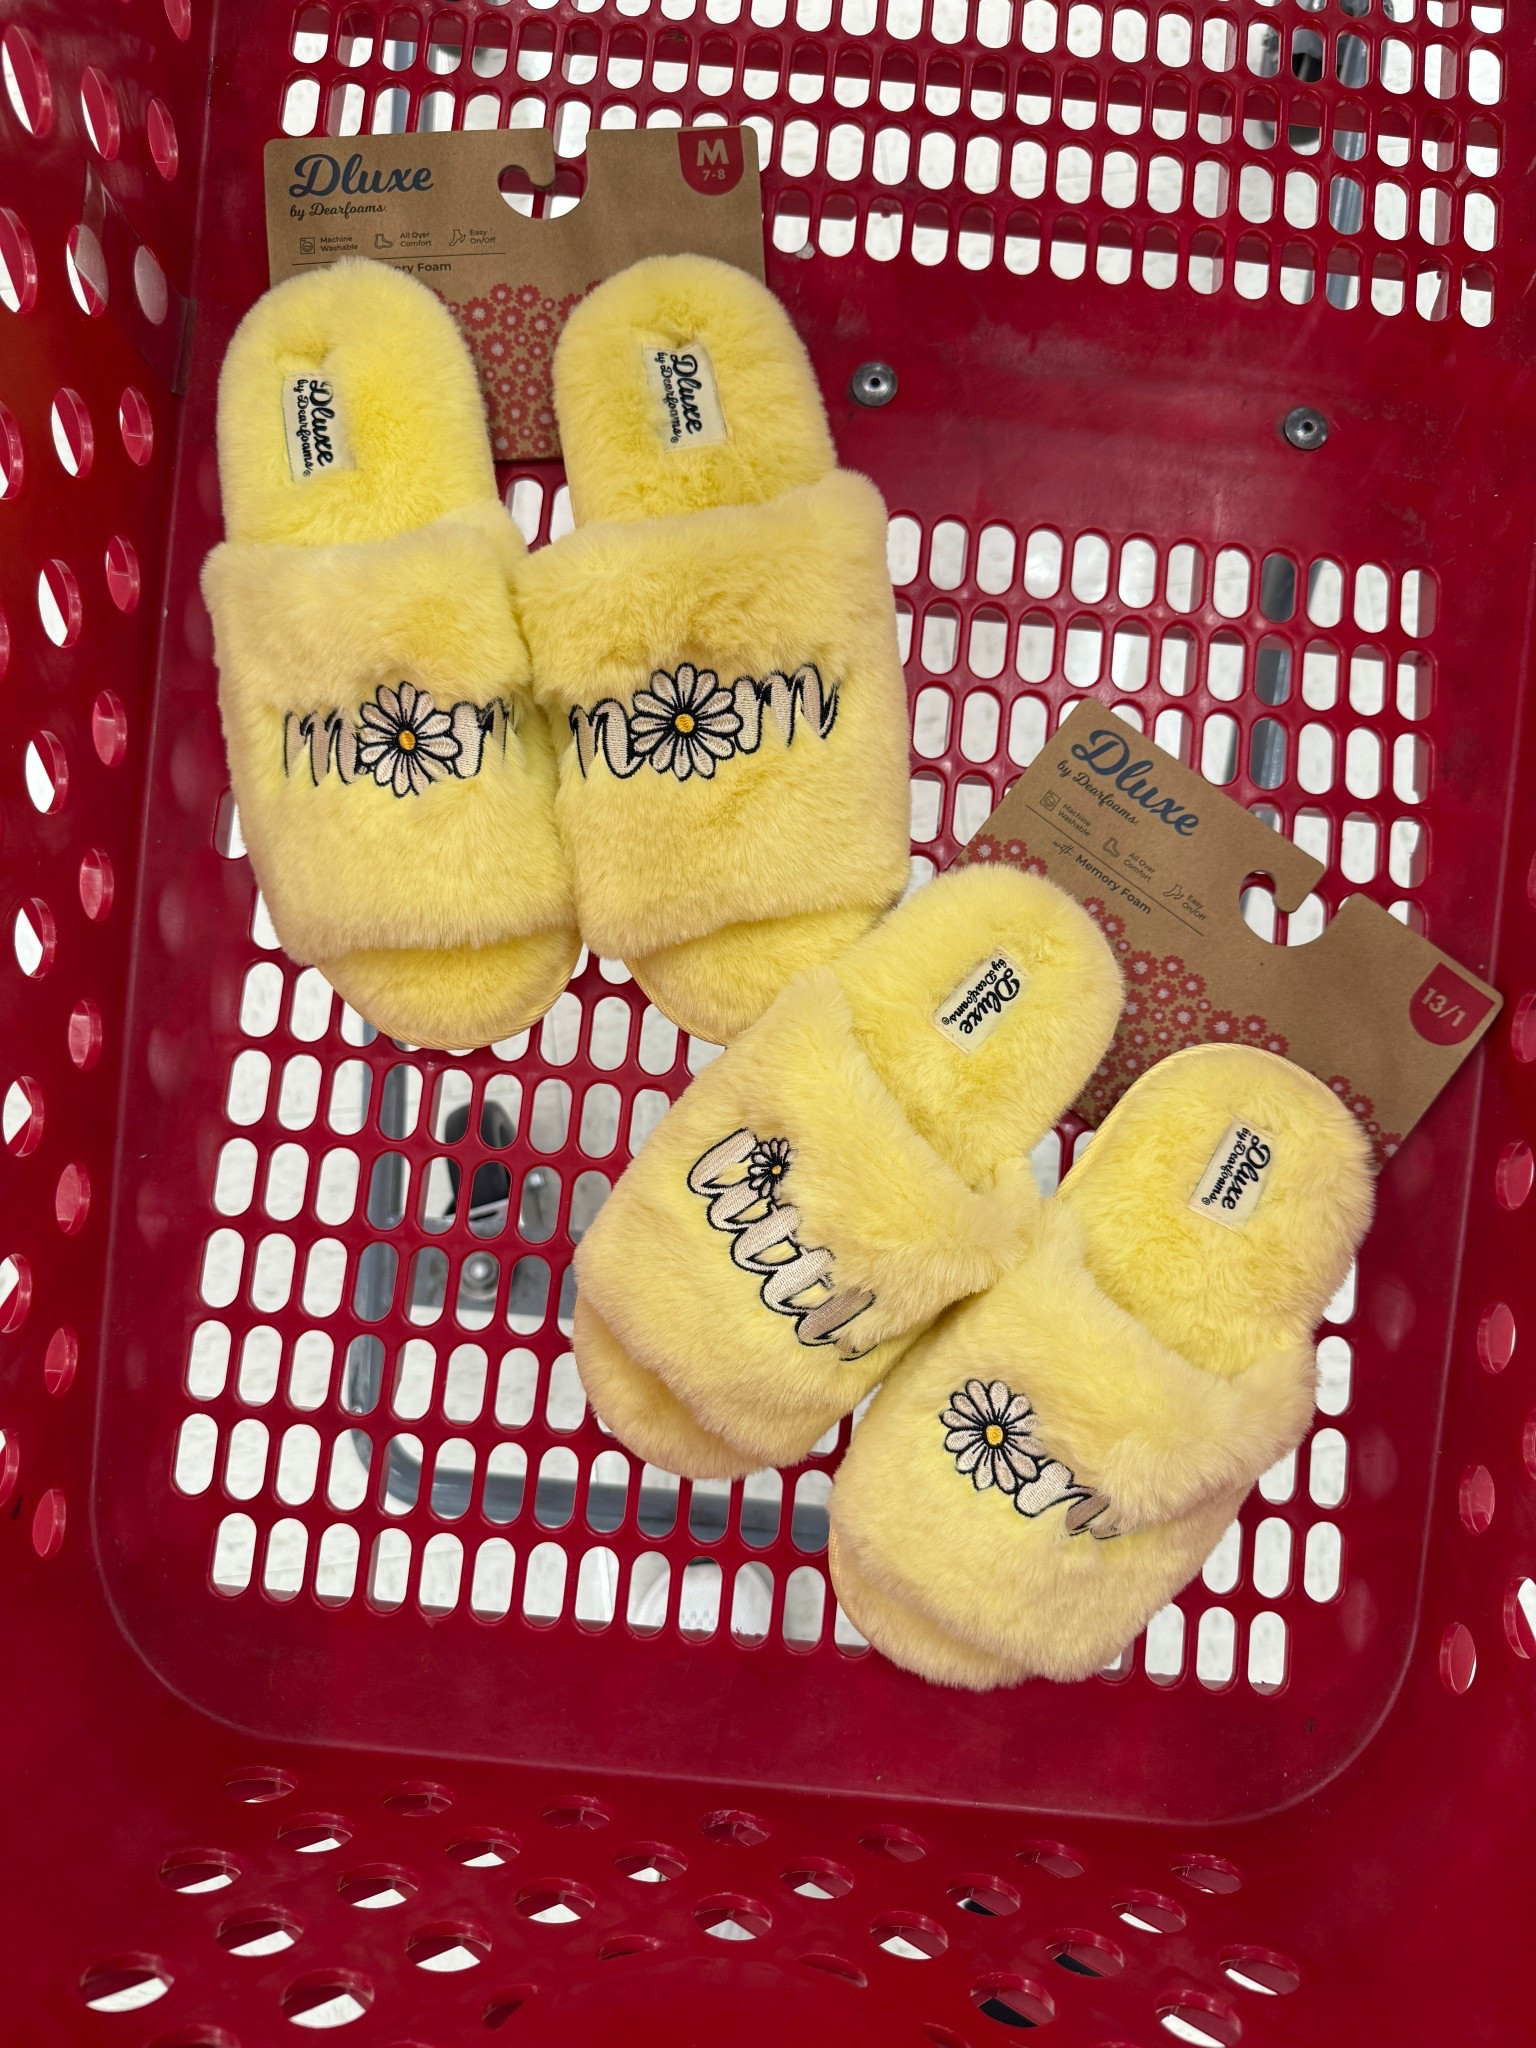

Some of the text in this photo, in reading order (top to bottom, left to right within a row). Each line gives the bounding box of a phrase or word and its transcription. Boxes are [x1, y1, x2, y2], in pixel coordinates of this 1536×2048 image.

[696, 138, 730, 167] M
[288, 153, 434, 198] Dluxe
[702, 168, 726, 181] 7-8
[290, 204, 306, 221] by
[320, 235, 353, 244] Machine
[469, 229, 488, 237] Easy
[469, 237, 497, 245] On/Off
[320, 243, 358, 252] Washable
[400, 240, 433, 248] Comfort
[417, 262, 452, 272] Foam
[654, 352, 668, 364] by
[293, 379, 309, 394] by
[670, 354, 702, 434] Dluxe
[309, 380, 336, 468] Dluxe
[1056, 760, 1072, 778] by
[1070, 729, 1200, 837] Dluxe
[1057, 810, 1091, 838] Washable
[1062, 803, 1093, 827] Machine
[1122, 859, 1153, 884] Comfort
[1128, 851, 1157, 875] All Over
[1075, 854, 1122, 893] Memory
[1119, 887, 1152, 915] Foam
[1186, 893, 1205, 909] Easy
[990, 958, 1008, 972] by
[959, 967, 1021, 1035] Dluxe
[1421, 987, 1467, 1028] 13/1
[1235, 1127, 1252, 1141] by
[1221, 1134, 1272, 1210] Dluxe
[686, 1126, 879, 1362] littl
